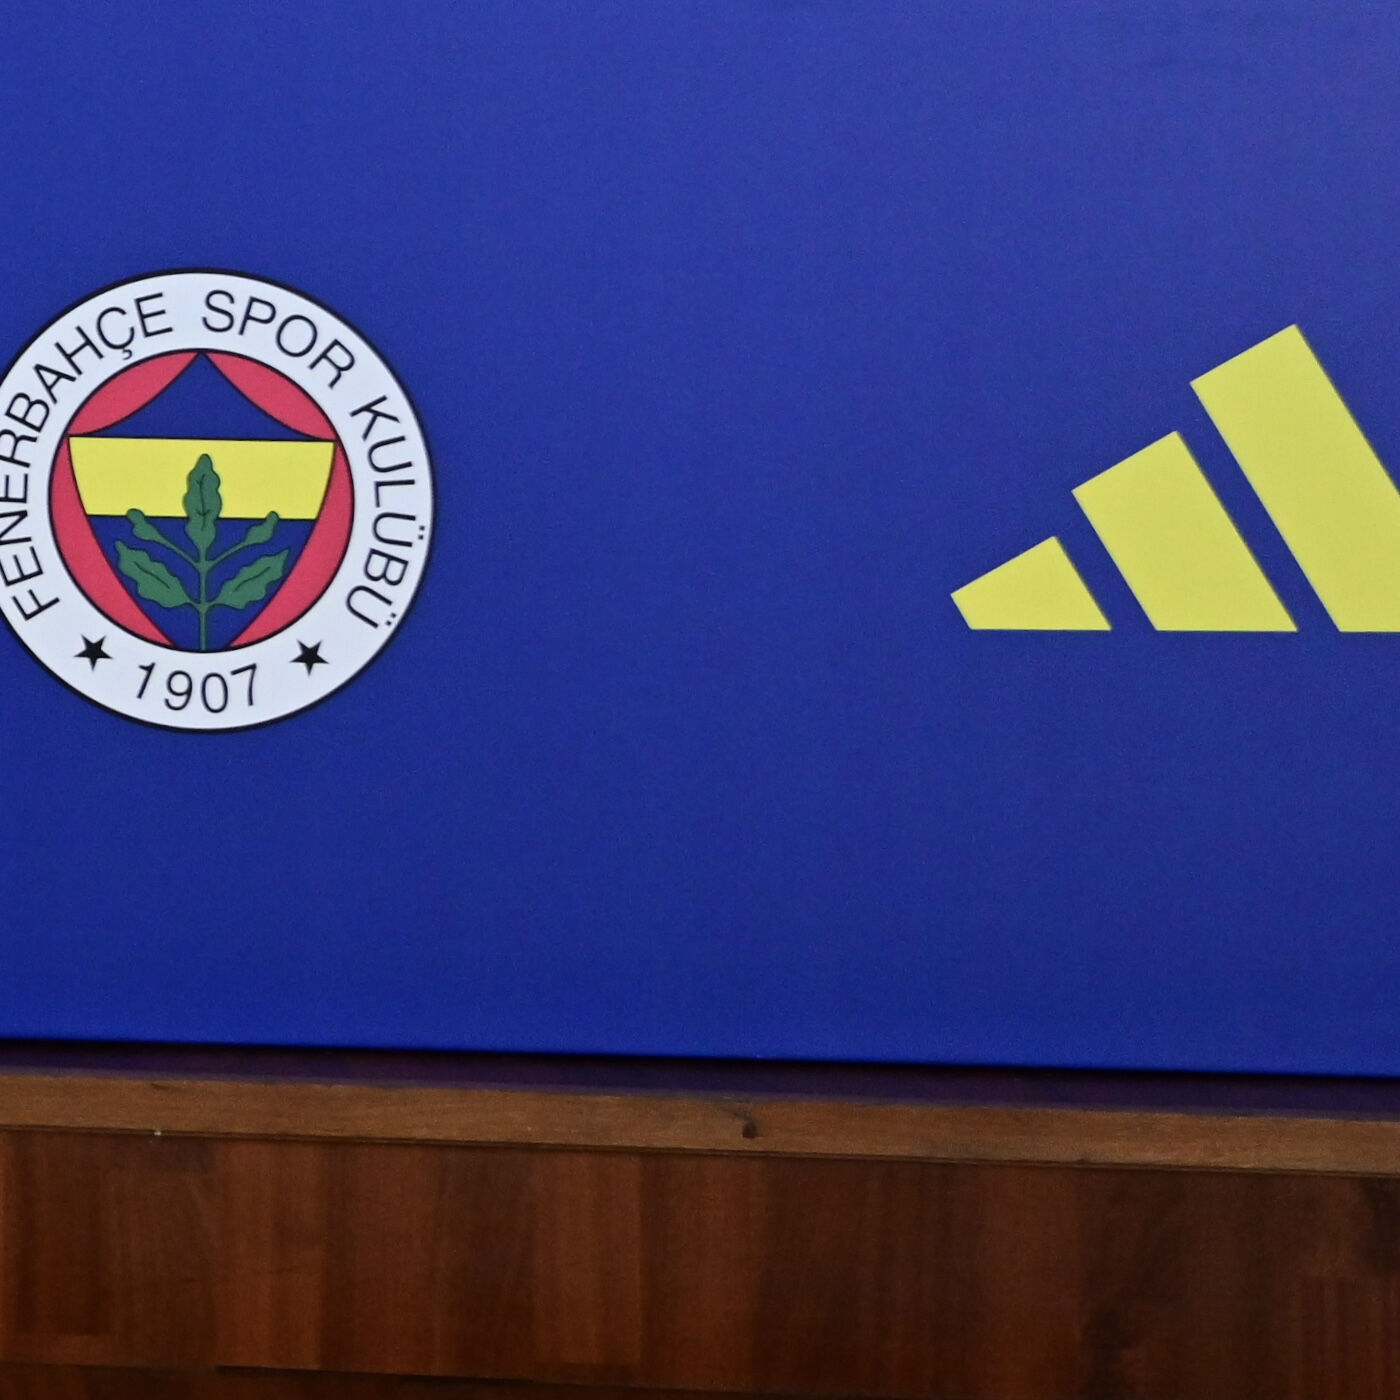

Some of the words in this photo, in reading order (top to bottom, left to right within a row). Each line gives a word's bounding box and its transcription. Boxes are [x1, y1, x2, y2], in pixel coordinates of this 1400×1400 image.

[201, 288, 356, 389] SPOR
[345, 394, 425, 629] KULÜBÜ
[136, 661, 258, 714] 1907
